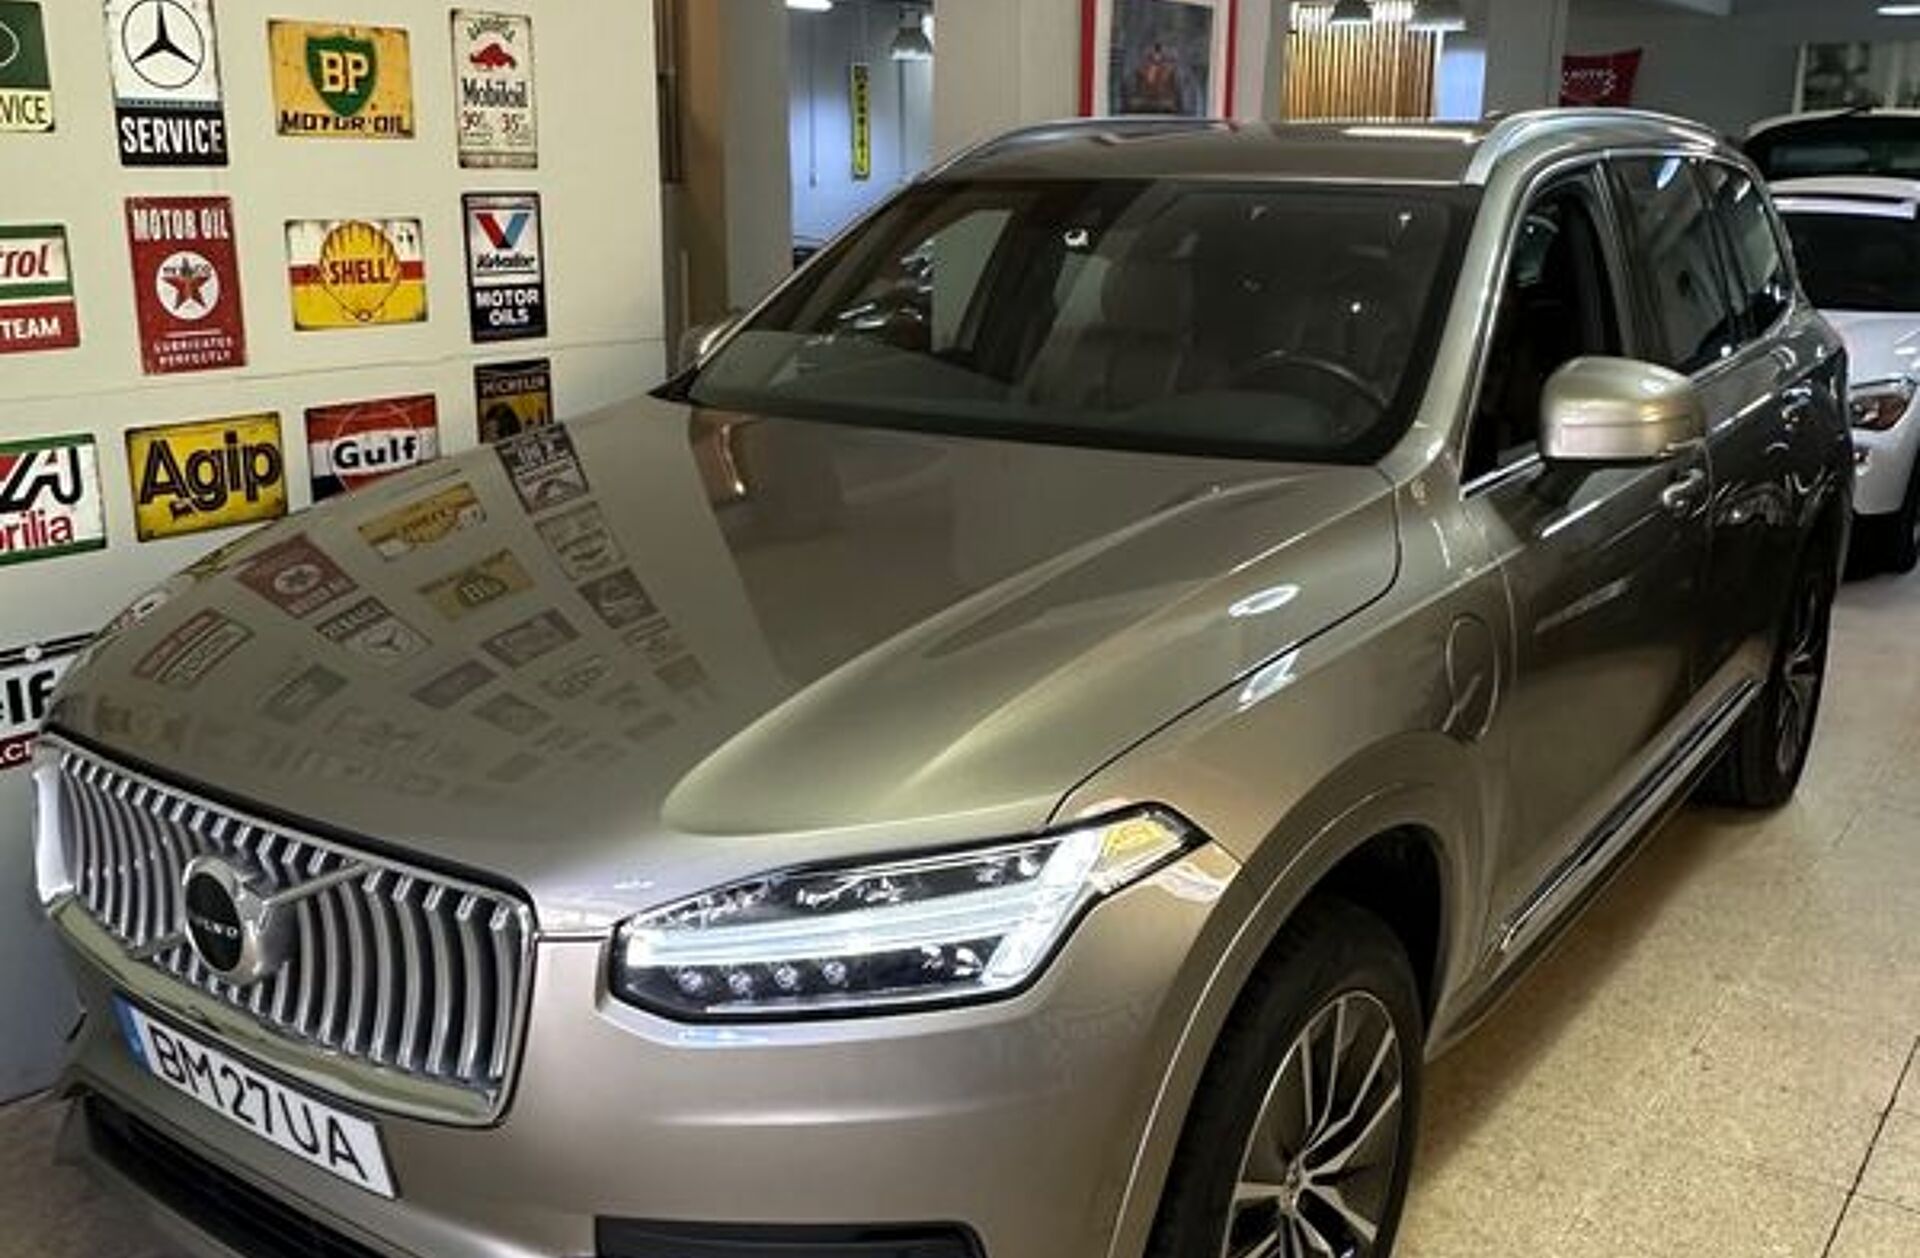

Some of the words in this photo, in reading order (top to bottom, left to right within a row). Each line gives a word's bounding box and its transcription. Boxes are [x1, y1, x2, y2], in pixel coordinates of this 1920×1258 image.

[318, 50, 369, 94] BP
[0, 94, 48, 124] VICE
[281, 110, 367, 132] MOTOR
[373, 115, 410, 134] OIL
[121, 116, 223, 153] SERVICE
[132, 208, 196, 240] MOTOR
[200, 208, 229, 239] OIL
[0, 244, 49, 278] rol
[328, 259, 392, 285] SHELL
[475, 289, 540, 308] MOTOR
[0, 317, 61, 339] TEAM
[488, 308, 530, 326] OILS
[333, 436, 417, 469] Gulf
[140, 430, 282, 512] Agip
[0, 509, 75, 551] rilia
[0, 669, 56, 725] lf
